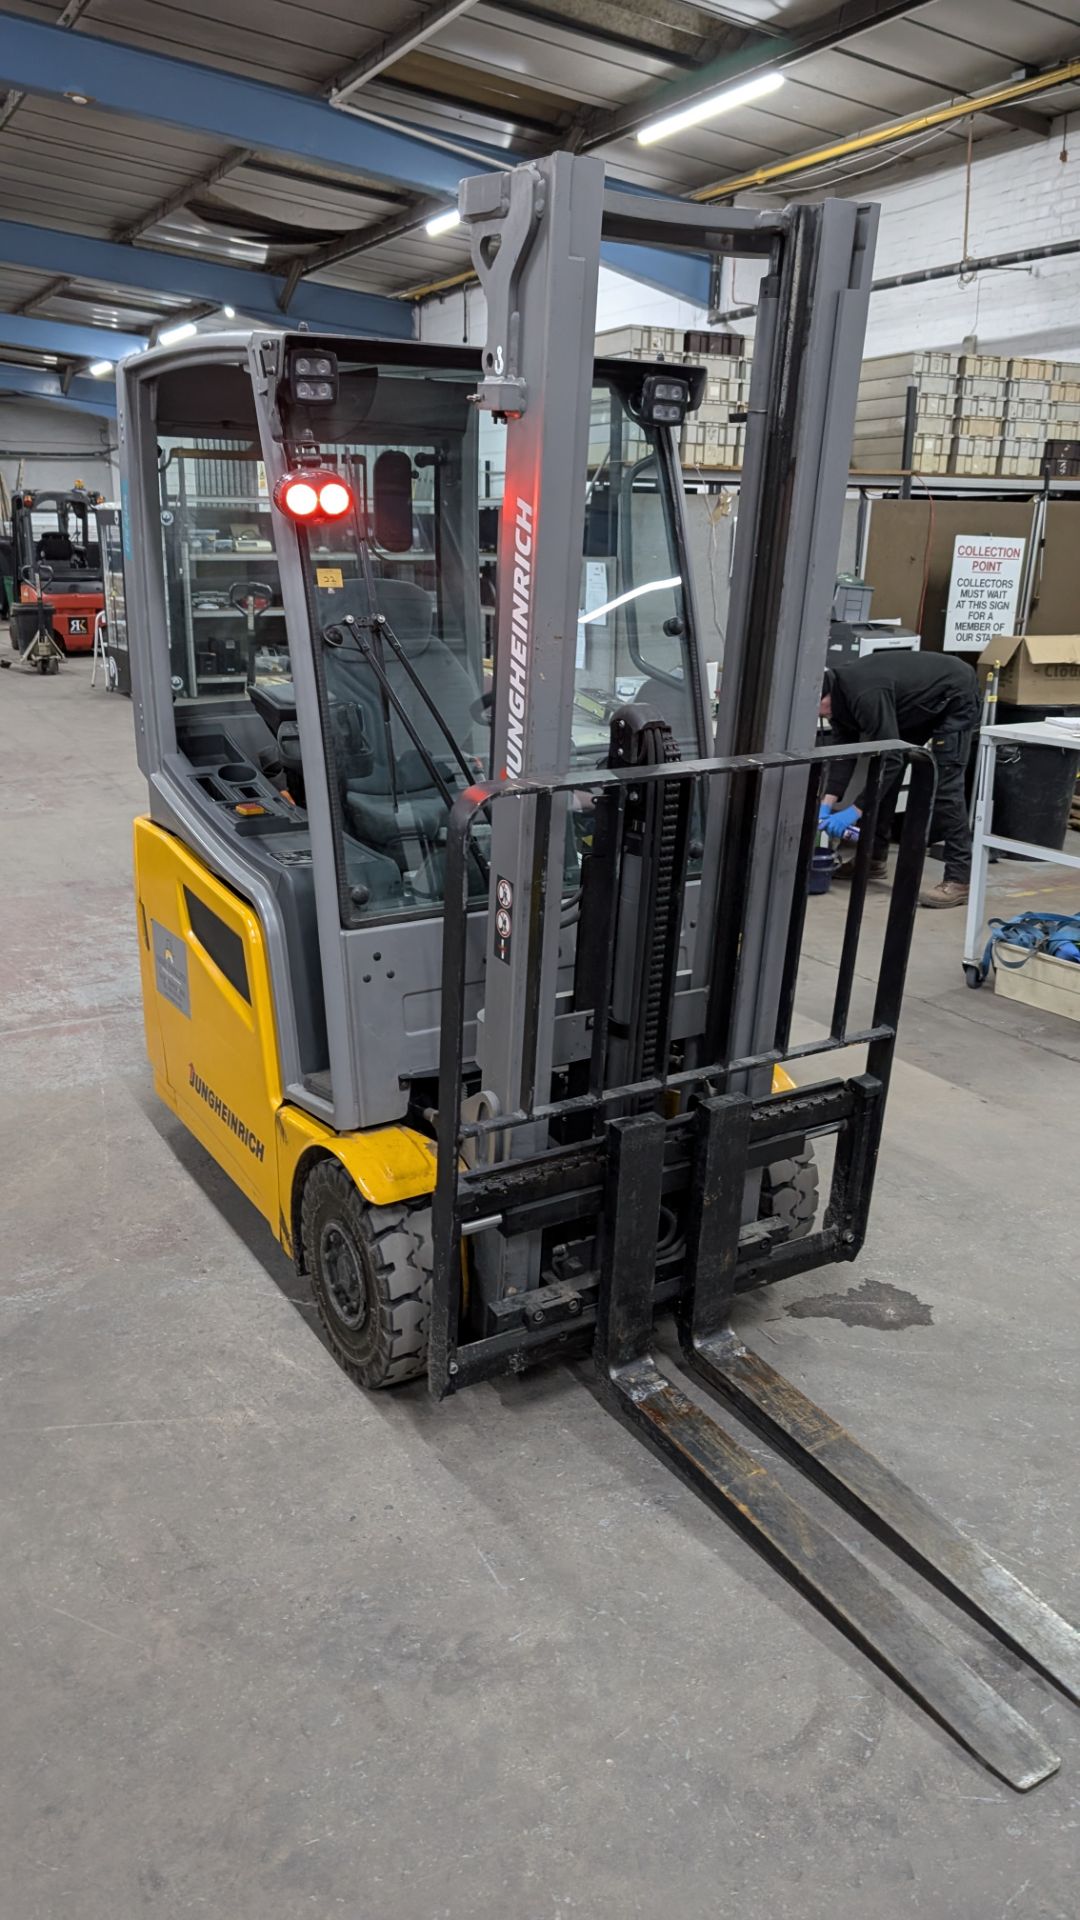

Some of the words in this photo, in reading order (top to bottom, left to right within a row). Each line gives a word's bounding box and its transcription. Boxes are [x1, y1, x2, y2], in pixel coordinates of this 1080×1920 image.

[957, 545, 1021, 558] COLLECTION
[971, 561, 1003, 572] POINT
[956, 578, 1014, 589] COLLECTORS
[960, 590, 985, 599] MUST
[987, 591, 1008, 599] WAIT
[955, 601, 966, 609] AT
[968, 601, 987, 609] THIS
[989, 601, 1010, 610] SIGN
[968, 612, 985, 620] FOR
[988, 612, 994, 620] A
[954, 622, 991, 631] MEMBER
[993, 623, 1005, 632] OF
[956, 633, 974, 642] OUR
[975, 633, 1002, 642] STA
[1045, 664, 1080, 678] Clou
[188, 1063, 266, 1163] JUNGHEINRICH
